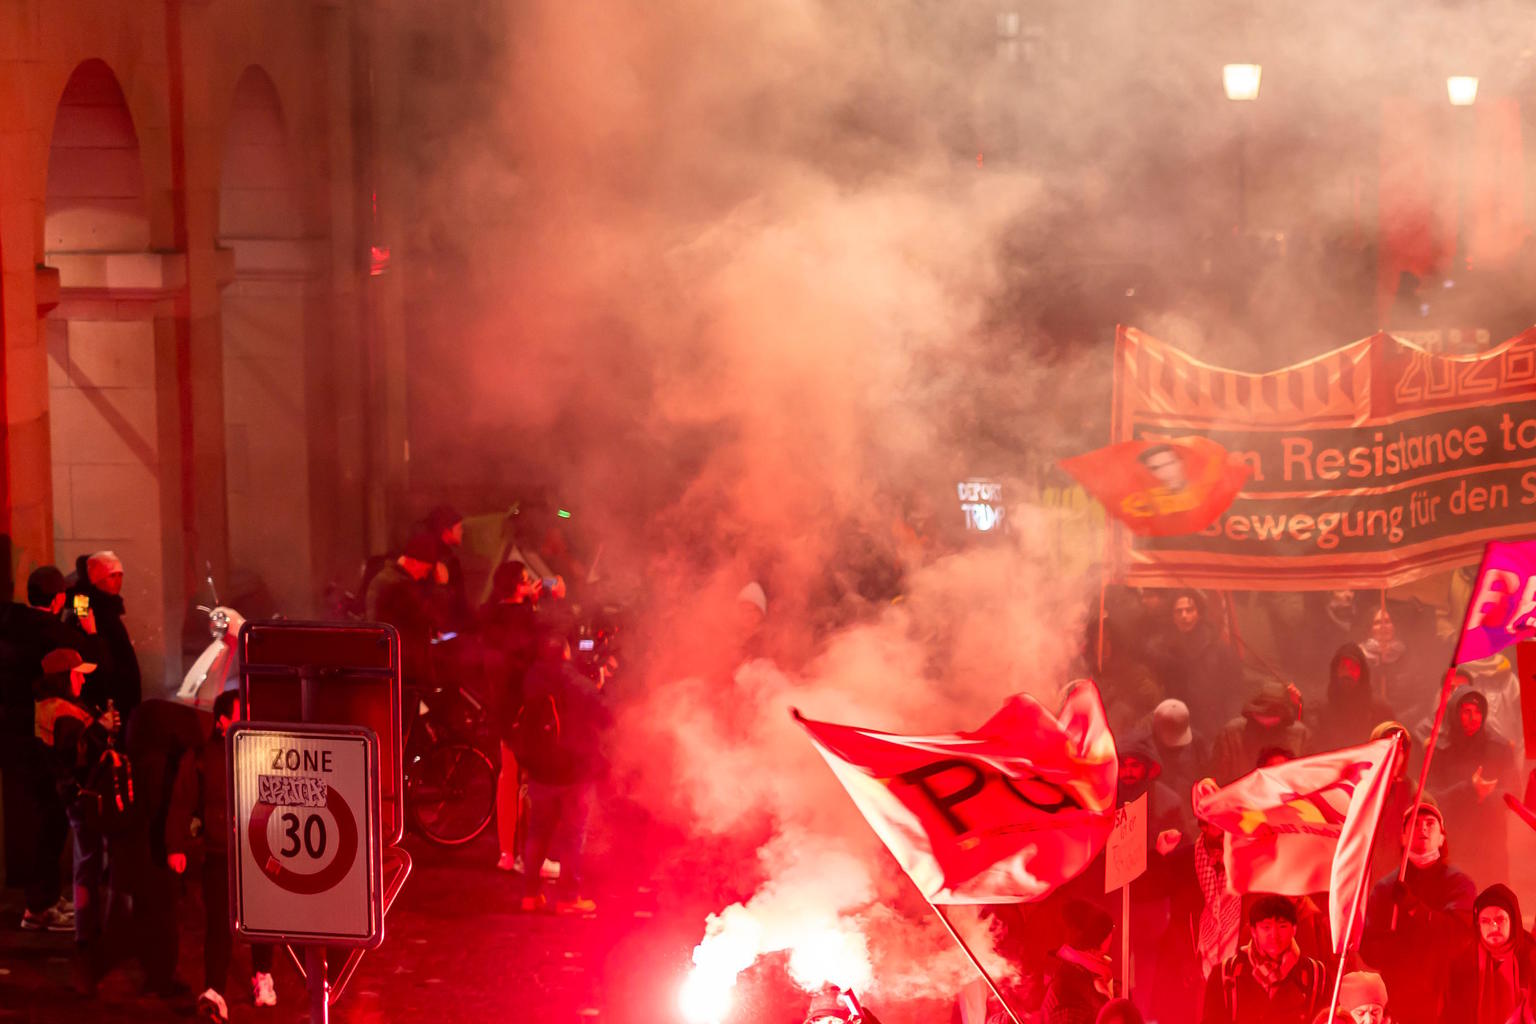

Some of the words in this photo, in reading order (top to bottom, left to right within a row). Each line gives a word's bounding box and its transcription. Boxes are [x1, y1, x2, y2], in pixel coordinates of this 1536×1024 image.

[1281, 424, 1488, 482] Resistance
[1409, 490, 1442, 529] für
[1449, 479, 1509, 516] den
[271, 749, 333, 773] ZONE
[280, 812, 327, 860] 30
